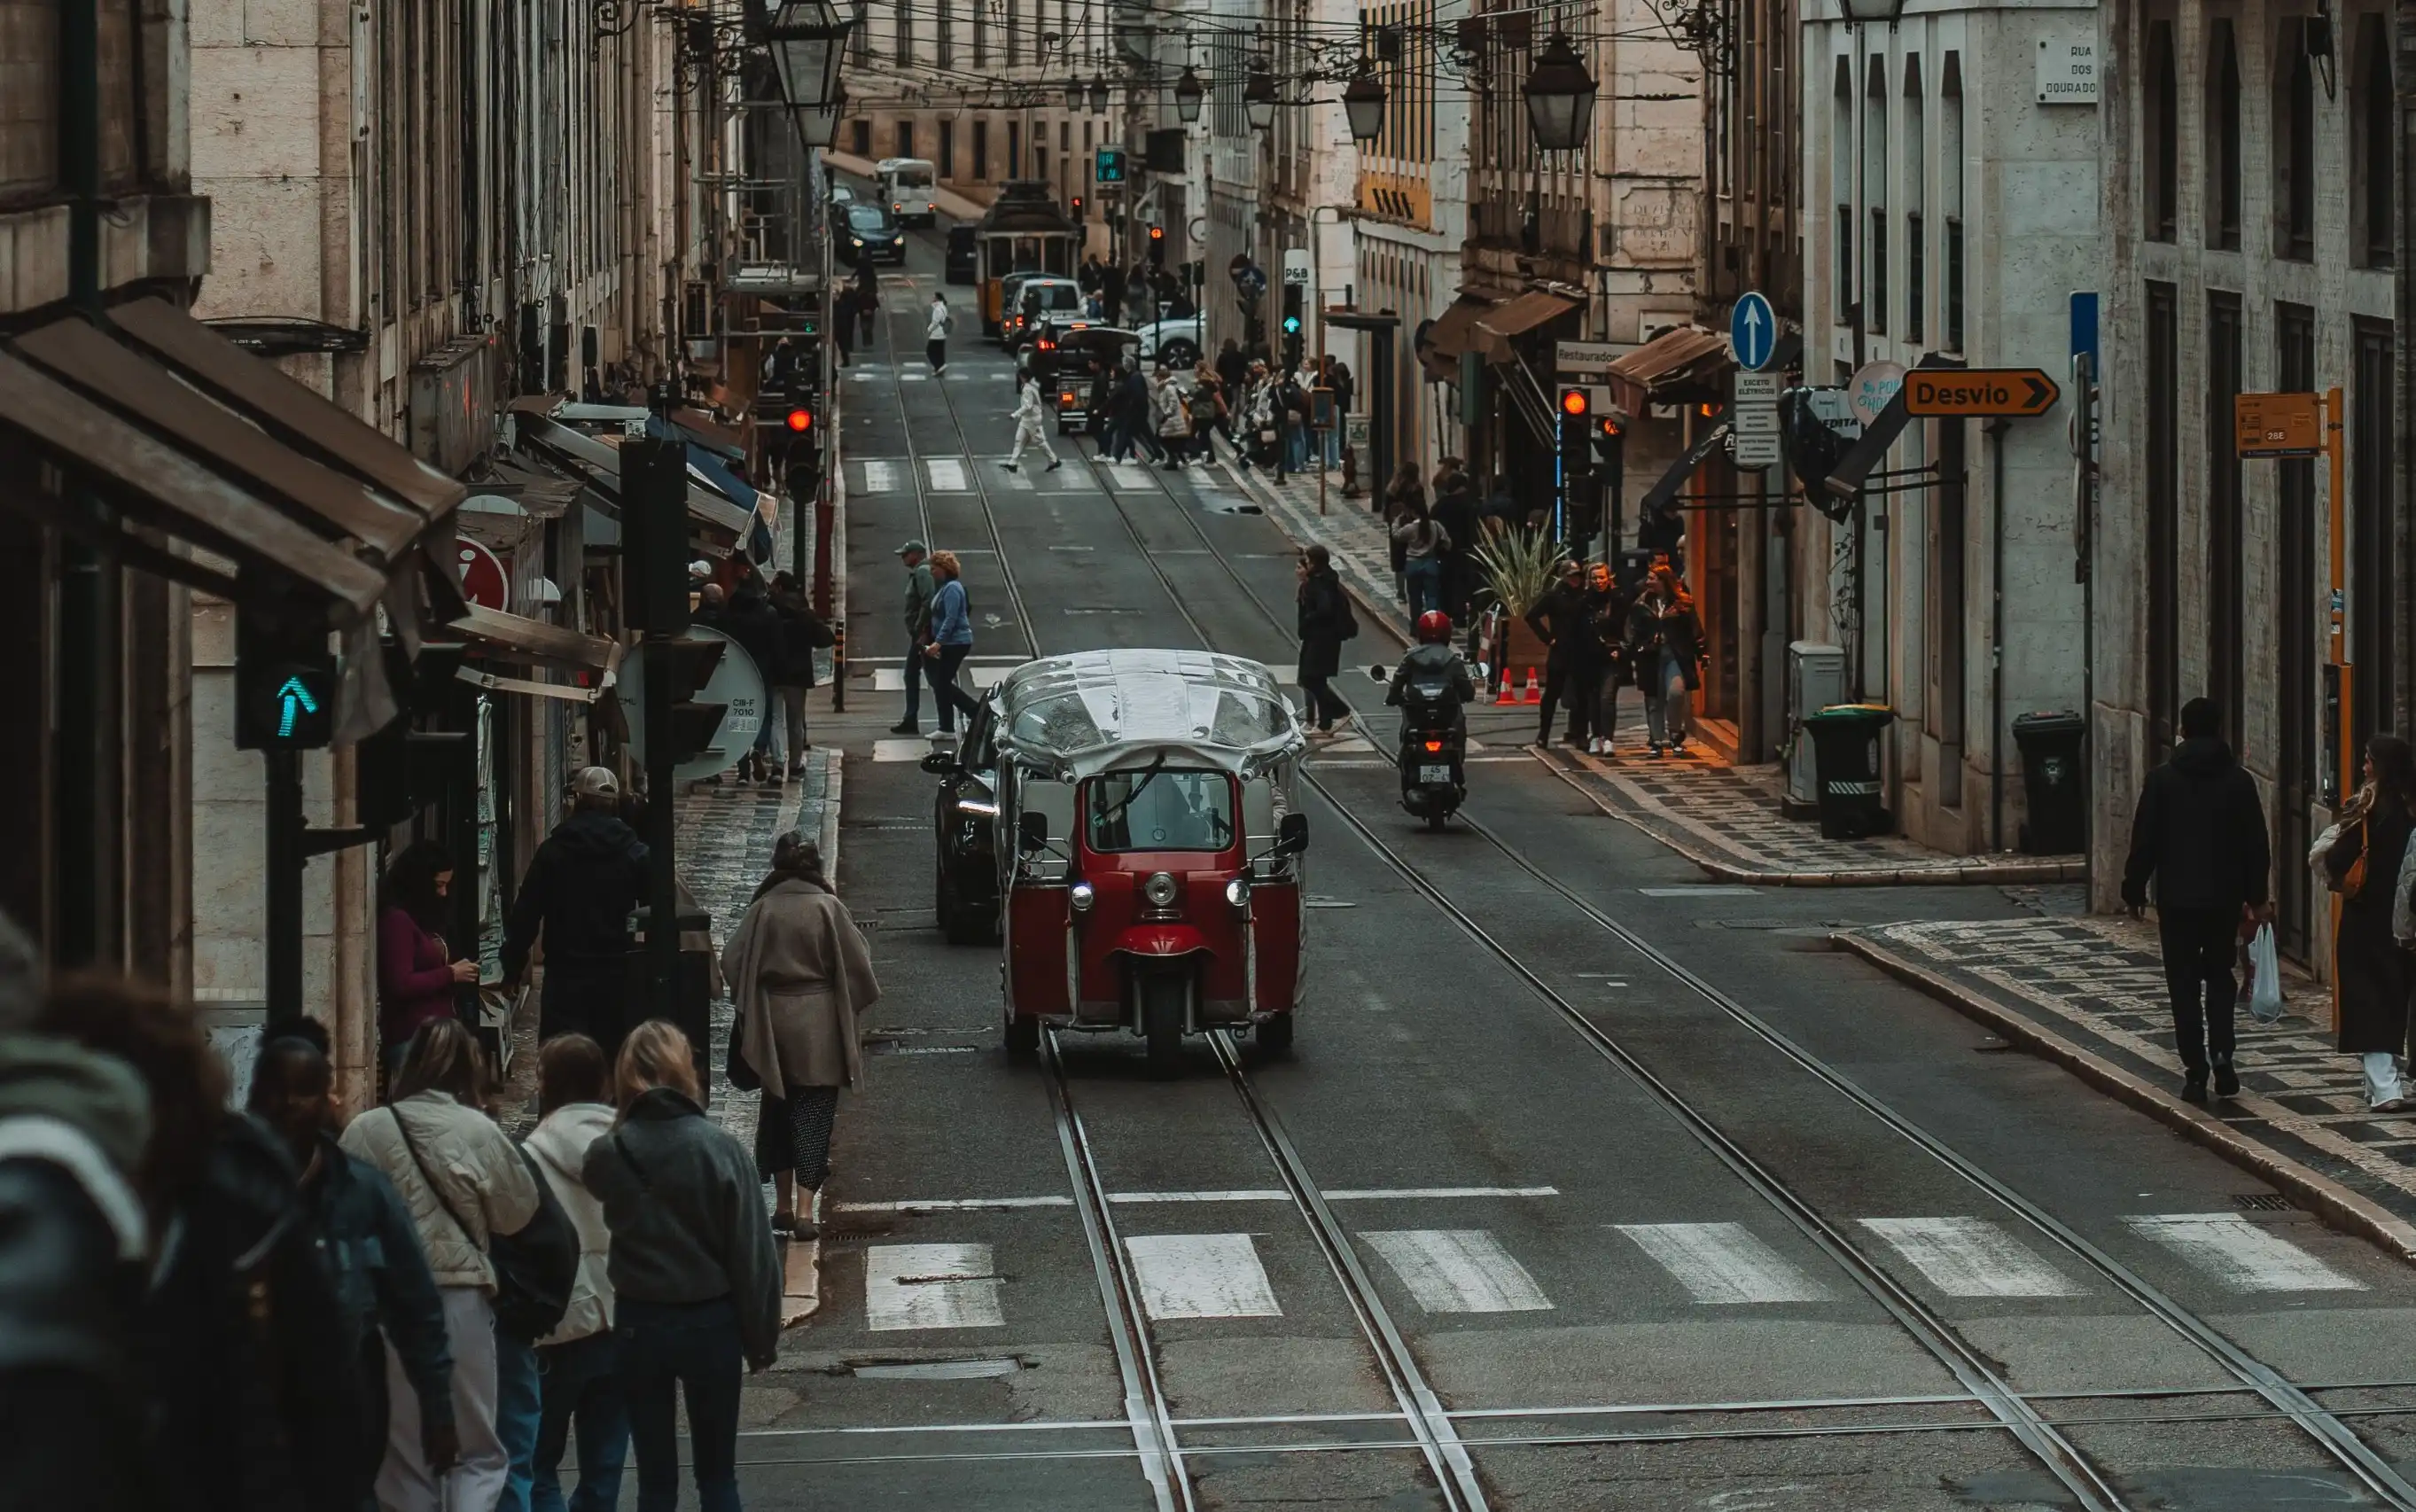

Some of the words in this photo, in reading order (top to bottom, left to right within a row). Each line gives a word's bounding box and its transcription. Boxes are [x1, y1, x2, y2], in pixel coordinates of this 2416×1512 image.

[2070, 47, 2092, 57] RUA
[2071, 65, 2093, 75] DOS
[1285, 268, 1308, 279] P&B
[1916, 381, 2009, 405] Desvio
[2266, 432, 2285, 440] 28E
